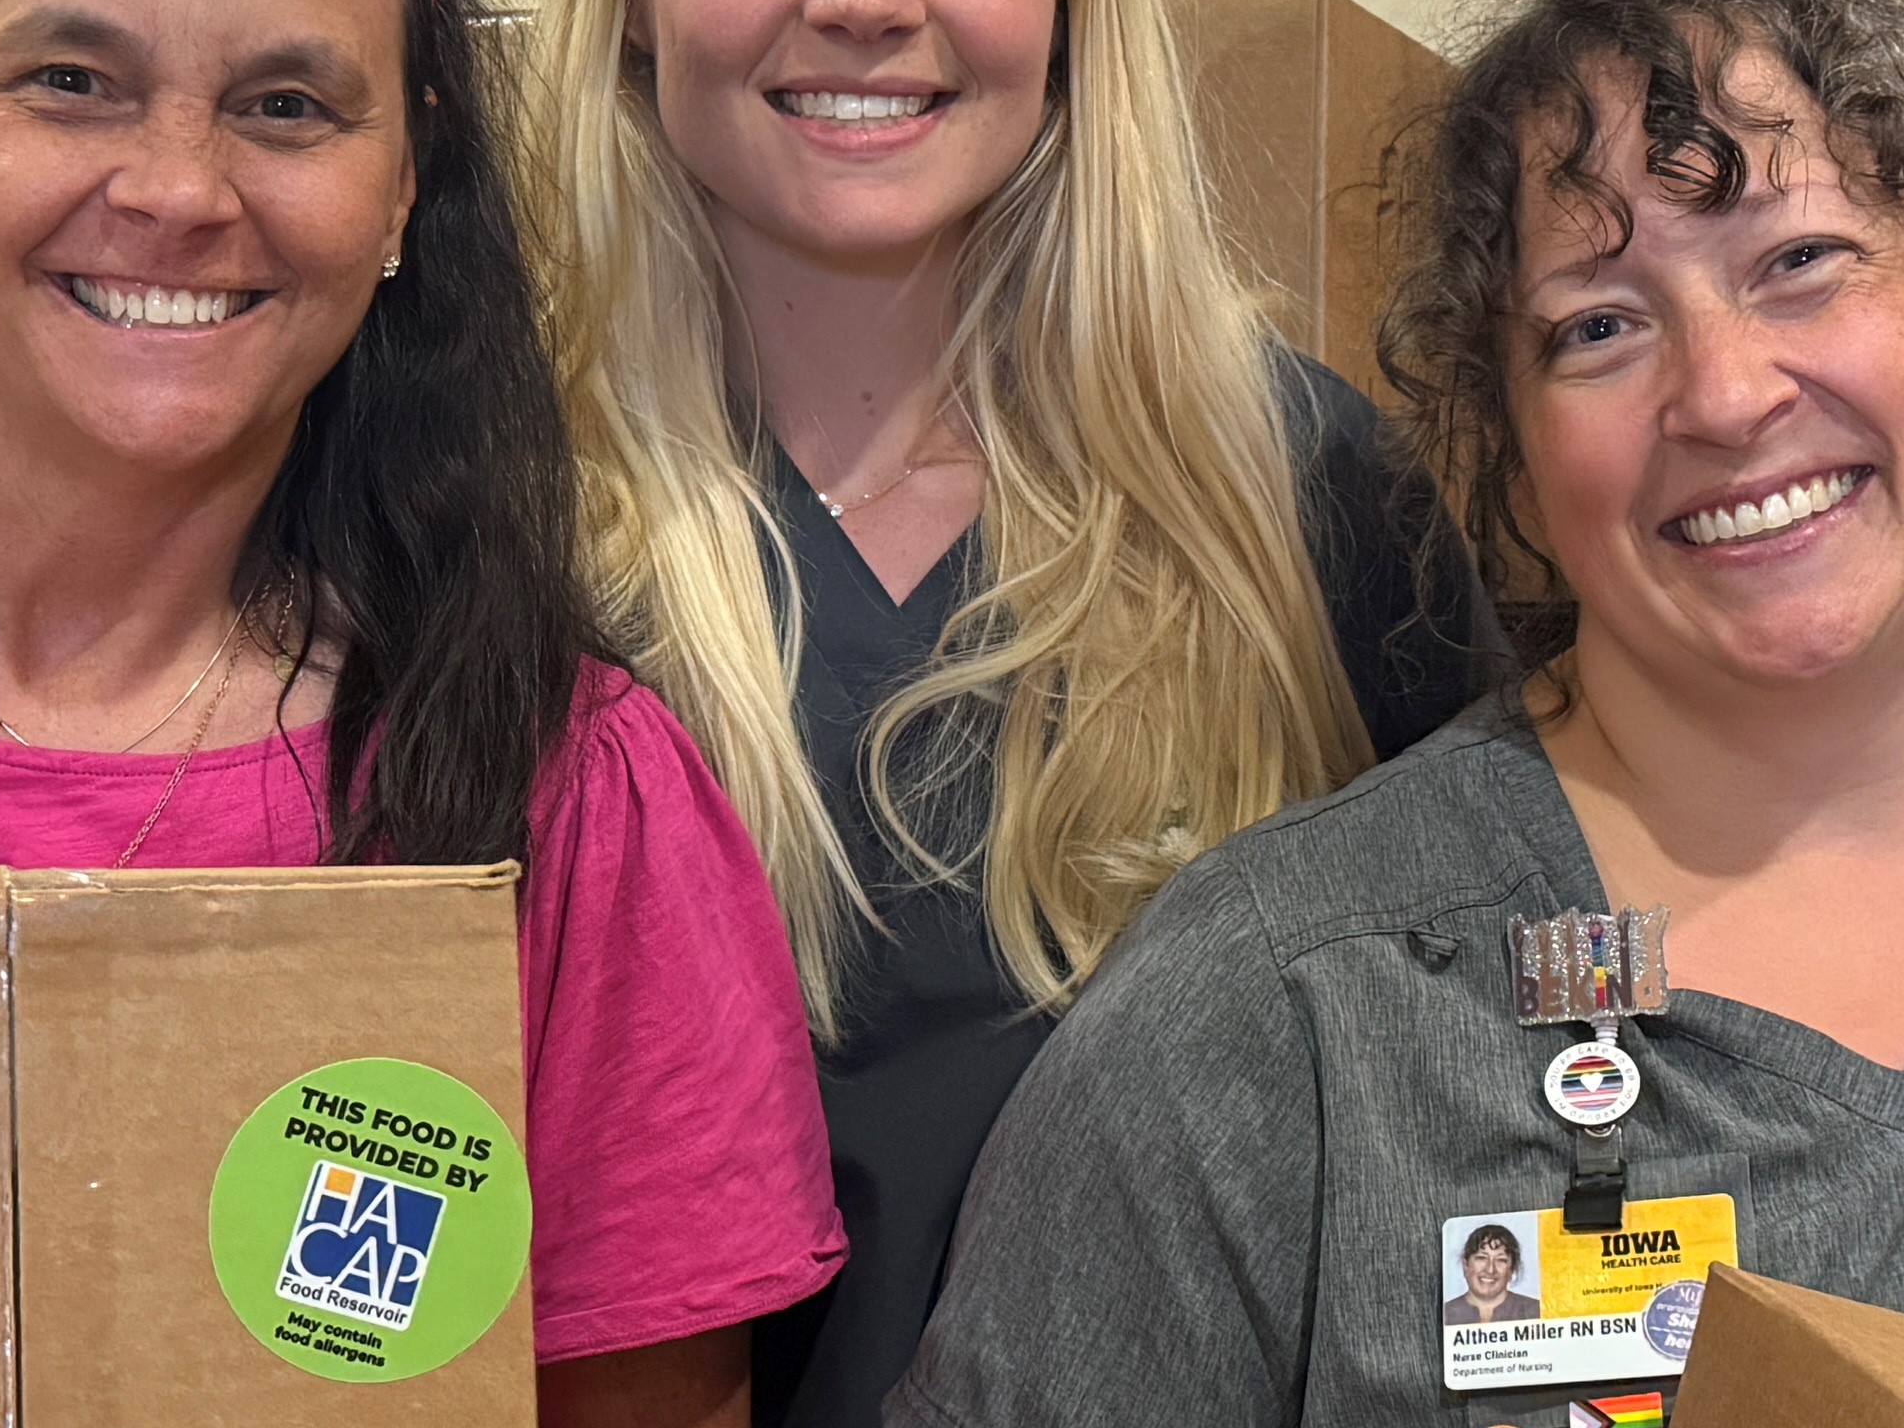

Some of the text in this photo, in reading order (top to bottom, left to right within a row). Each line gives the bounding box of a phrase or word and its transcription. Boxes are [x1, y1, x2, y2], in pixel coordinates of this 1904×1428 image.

[300, 1086, 492, 1161] THIS FOOD IS
[284, 1117, 489, 1193] PROVIDED BY
[1600, 1230, 1680, 1257] IOWA
[1602, 1254, 1681, 1269] HEALTH CARE
[278, 1276, 408, 1325] Food Reservoir
[1583, 1285, 1623, 1295] University
[1625, 1284, 1633, 1292] of
[287, 1311, 383, 1349] May contain
[1453, 1317, 1636, 1346] Althea Miller RN BSN
[274, 1325, 386, 1368] food allergens
[1453, 1350, 1528, 1362] Nurse Clinician
[1453, 1363, 1553, 1377] Department of Nursing
